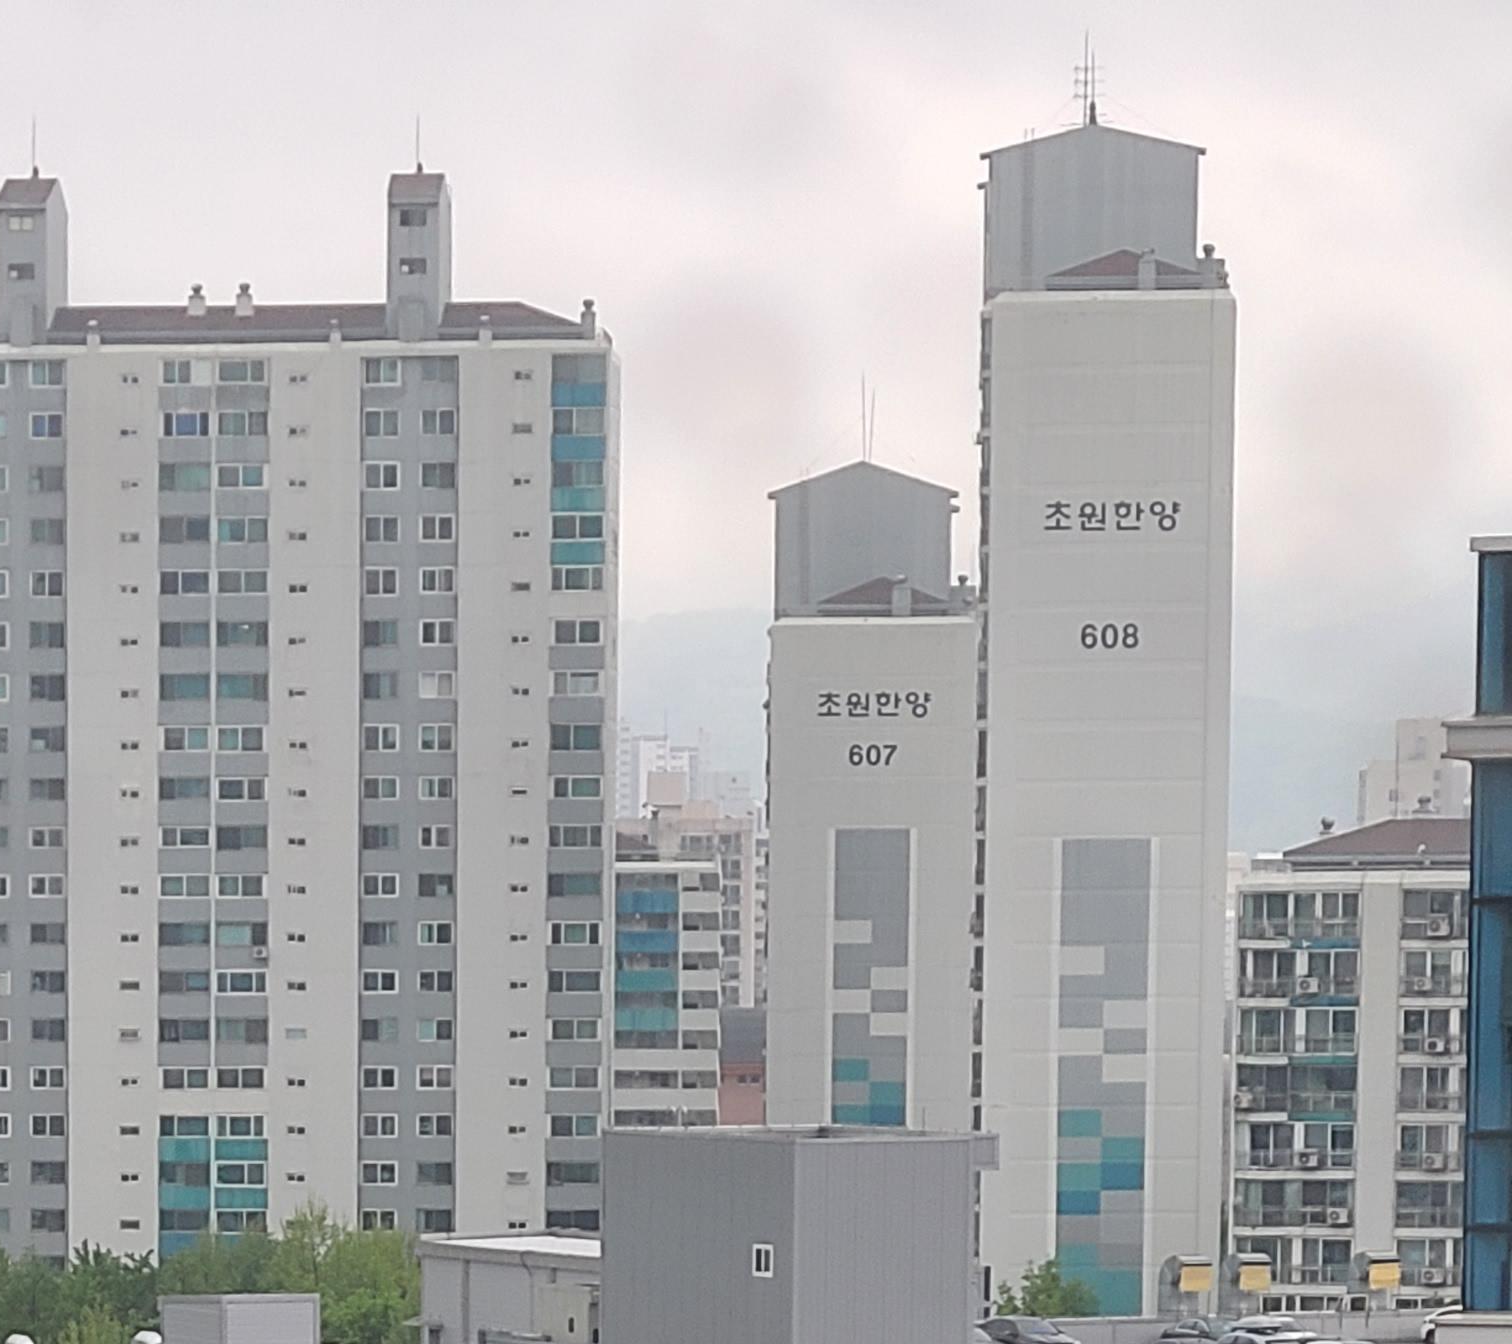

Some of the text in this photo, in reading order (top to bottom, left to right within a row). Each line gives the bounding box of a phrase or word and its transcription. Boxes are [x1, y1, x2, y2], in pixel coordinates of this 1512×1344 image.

[1043, 501, 1181, 531] 초원한양
[1080, 623, 1140, 649] 608
[817, 692, 932, 718] 초원한양
[849, 744, 898, 766] 607
